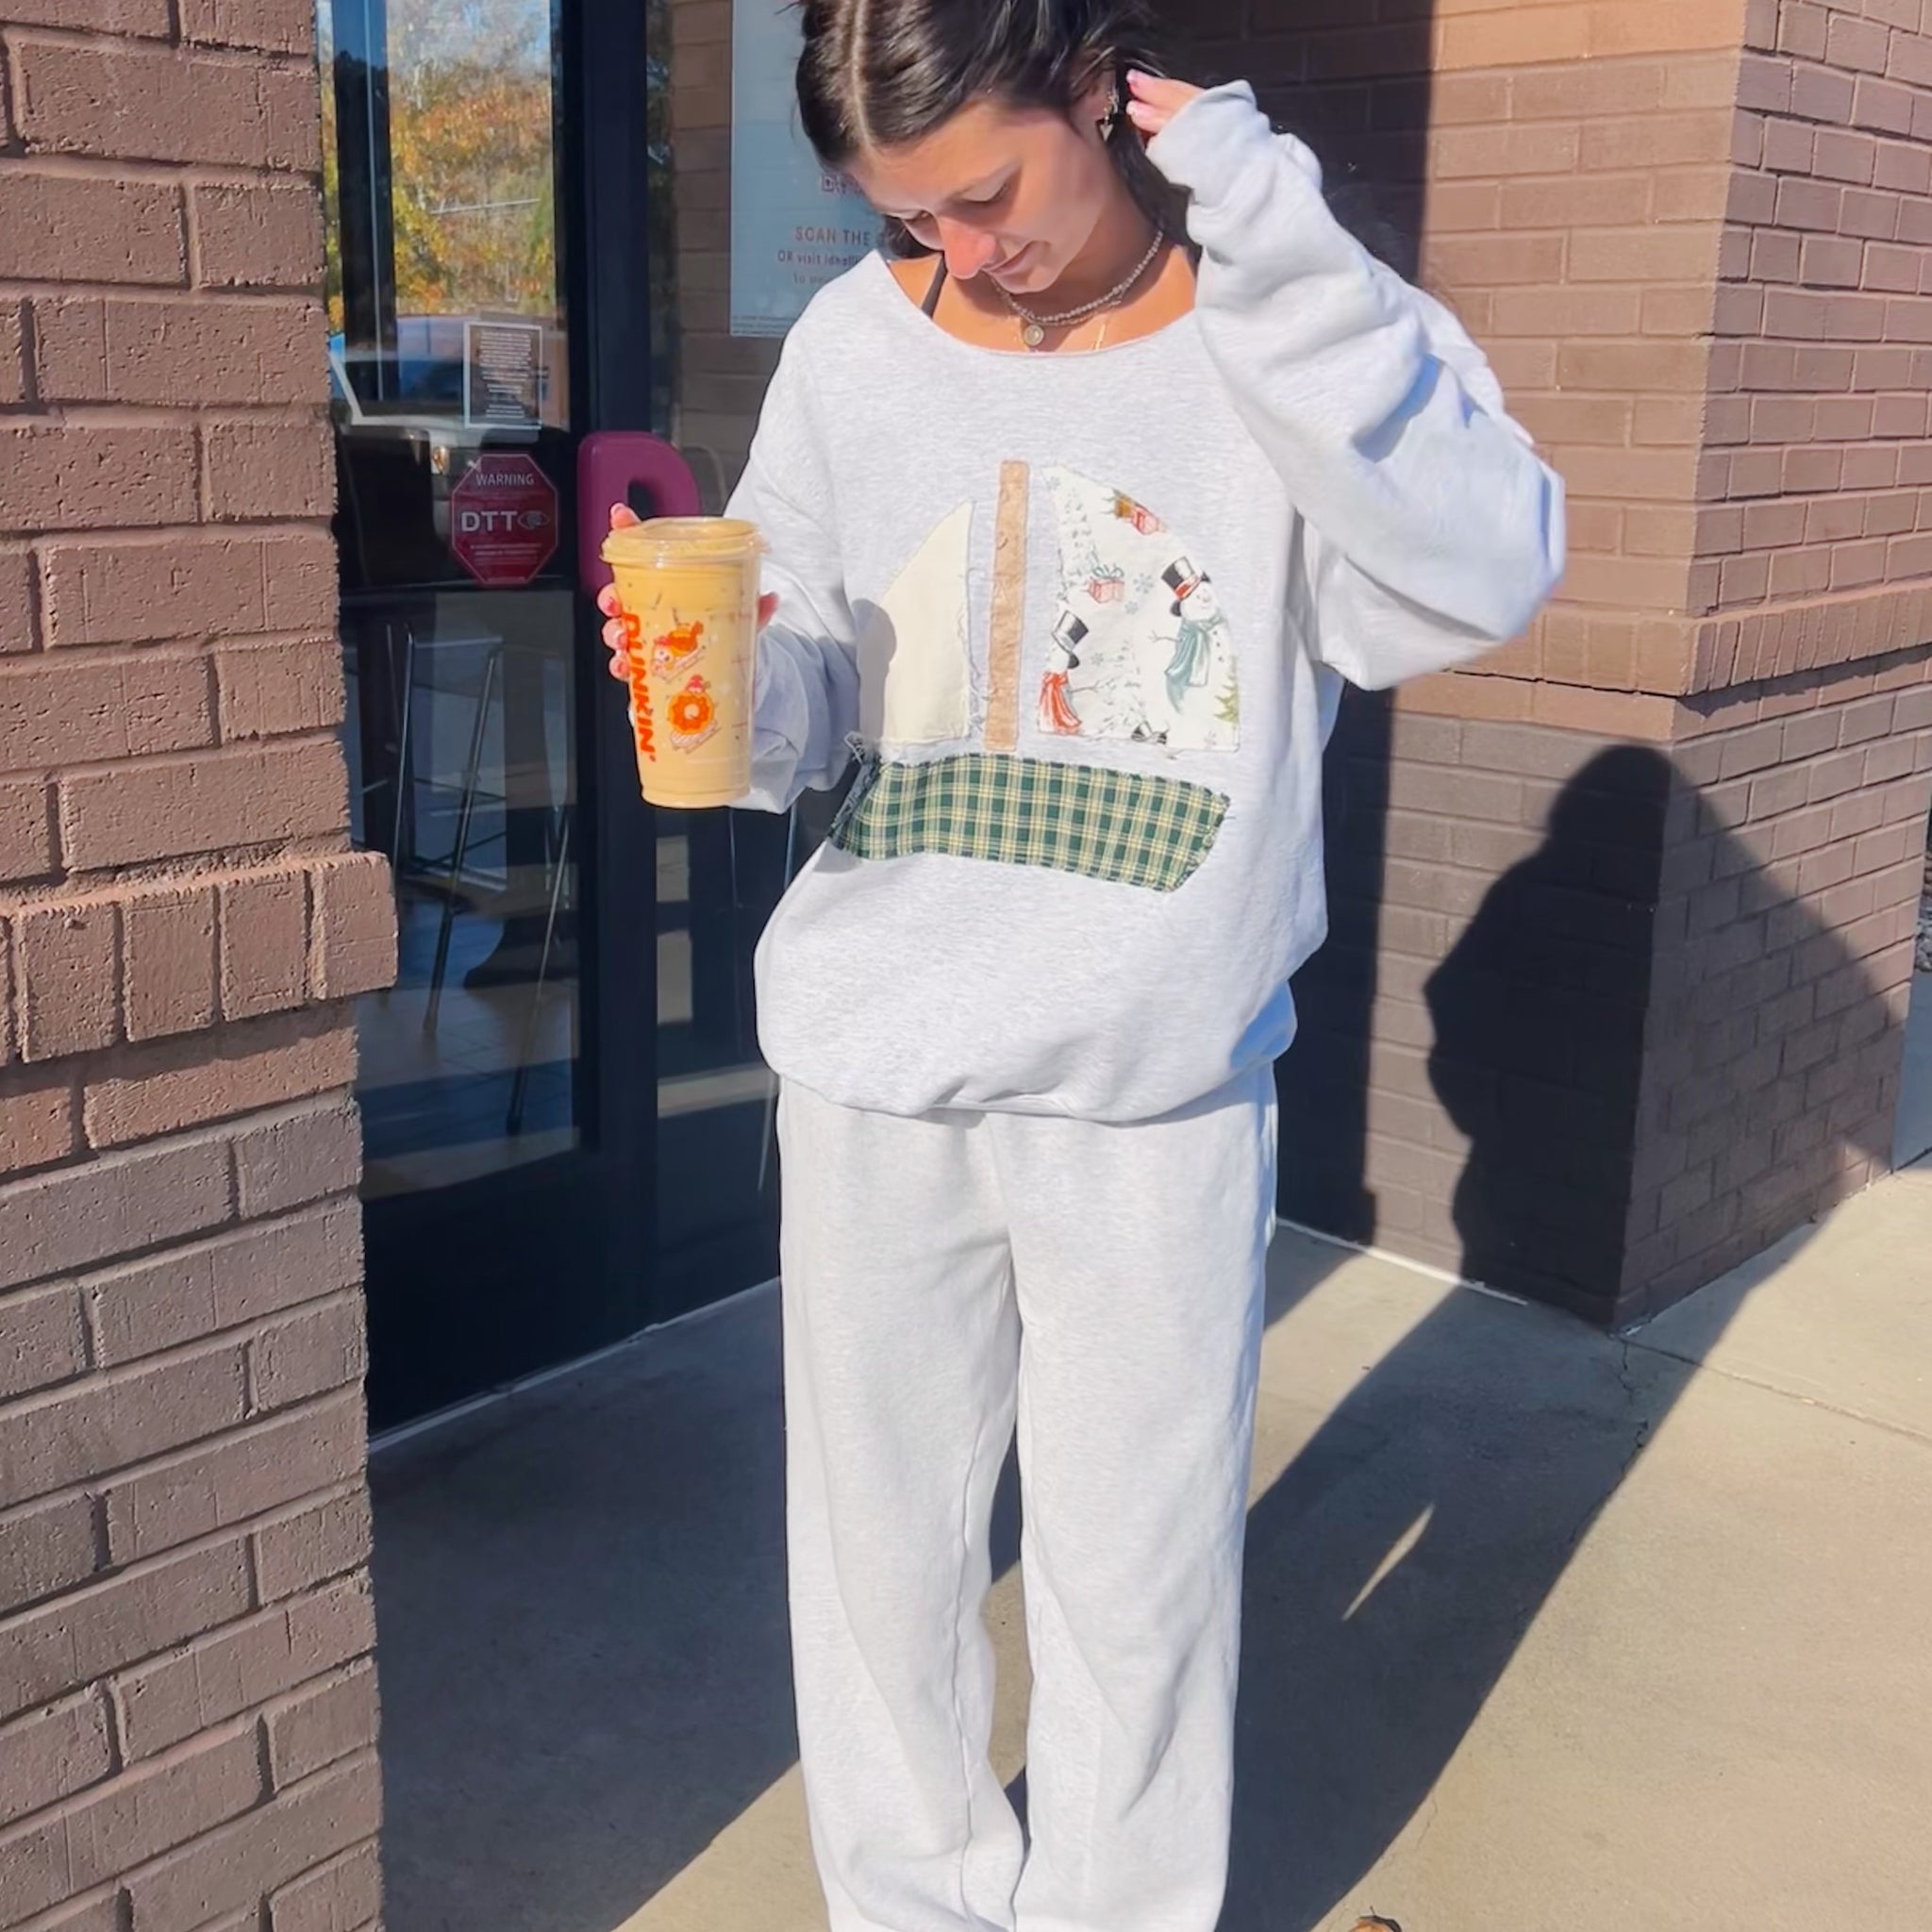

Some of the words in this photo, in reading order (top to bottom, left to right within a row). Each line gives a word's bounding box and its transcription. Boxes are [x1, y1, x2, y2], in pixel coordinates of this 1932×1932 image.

[794, 226, 837, 244] SCAN
[842, 228, 870, 246] THE
[777, 249, 792, 262] OR
[797, 252, 821, 265] visit
[475, 473, 535, 487] WARNING
[460, 510, 518, 533] DTT
